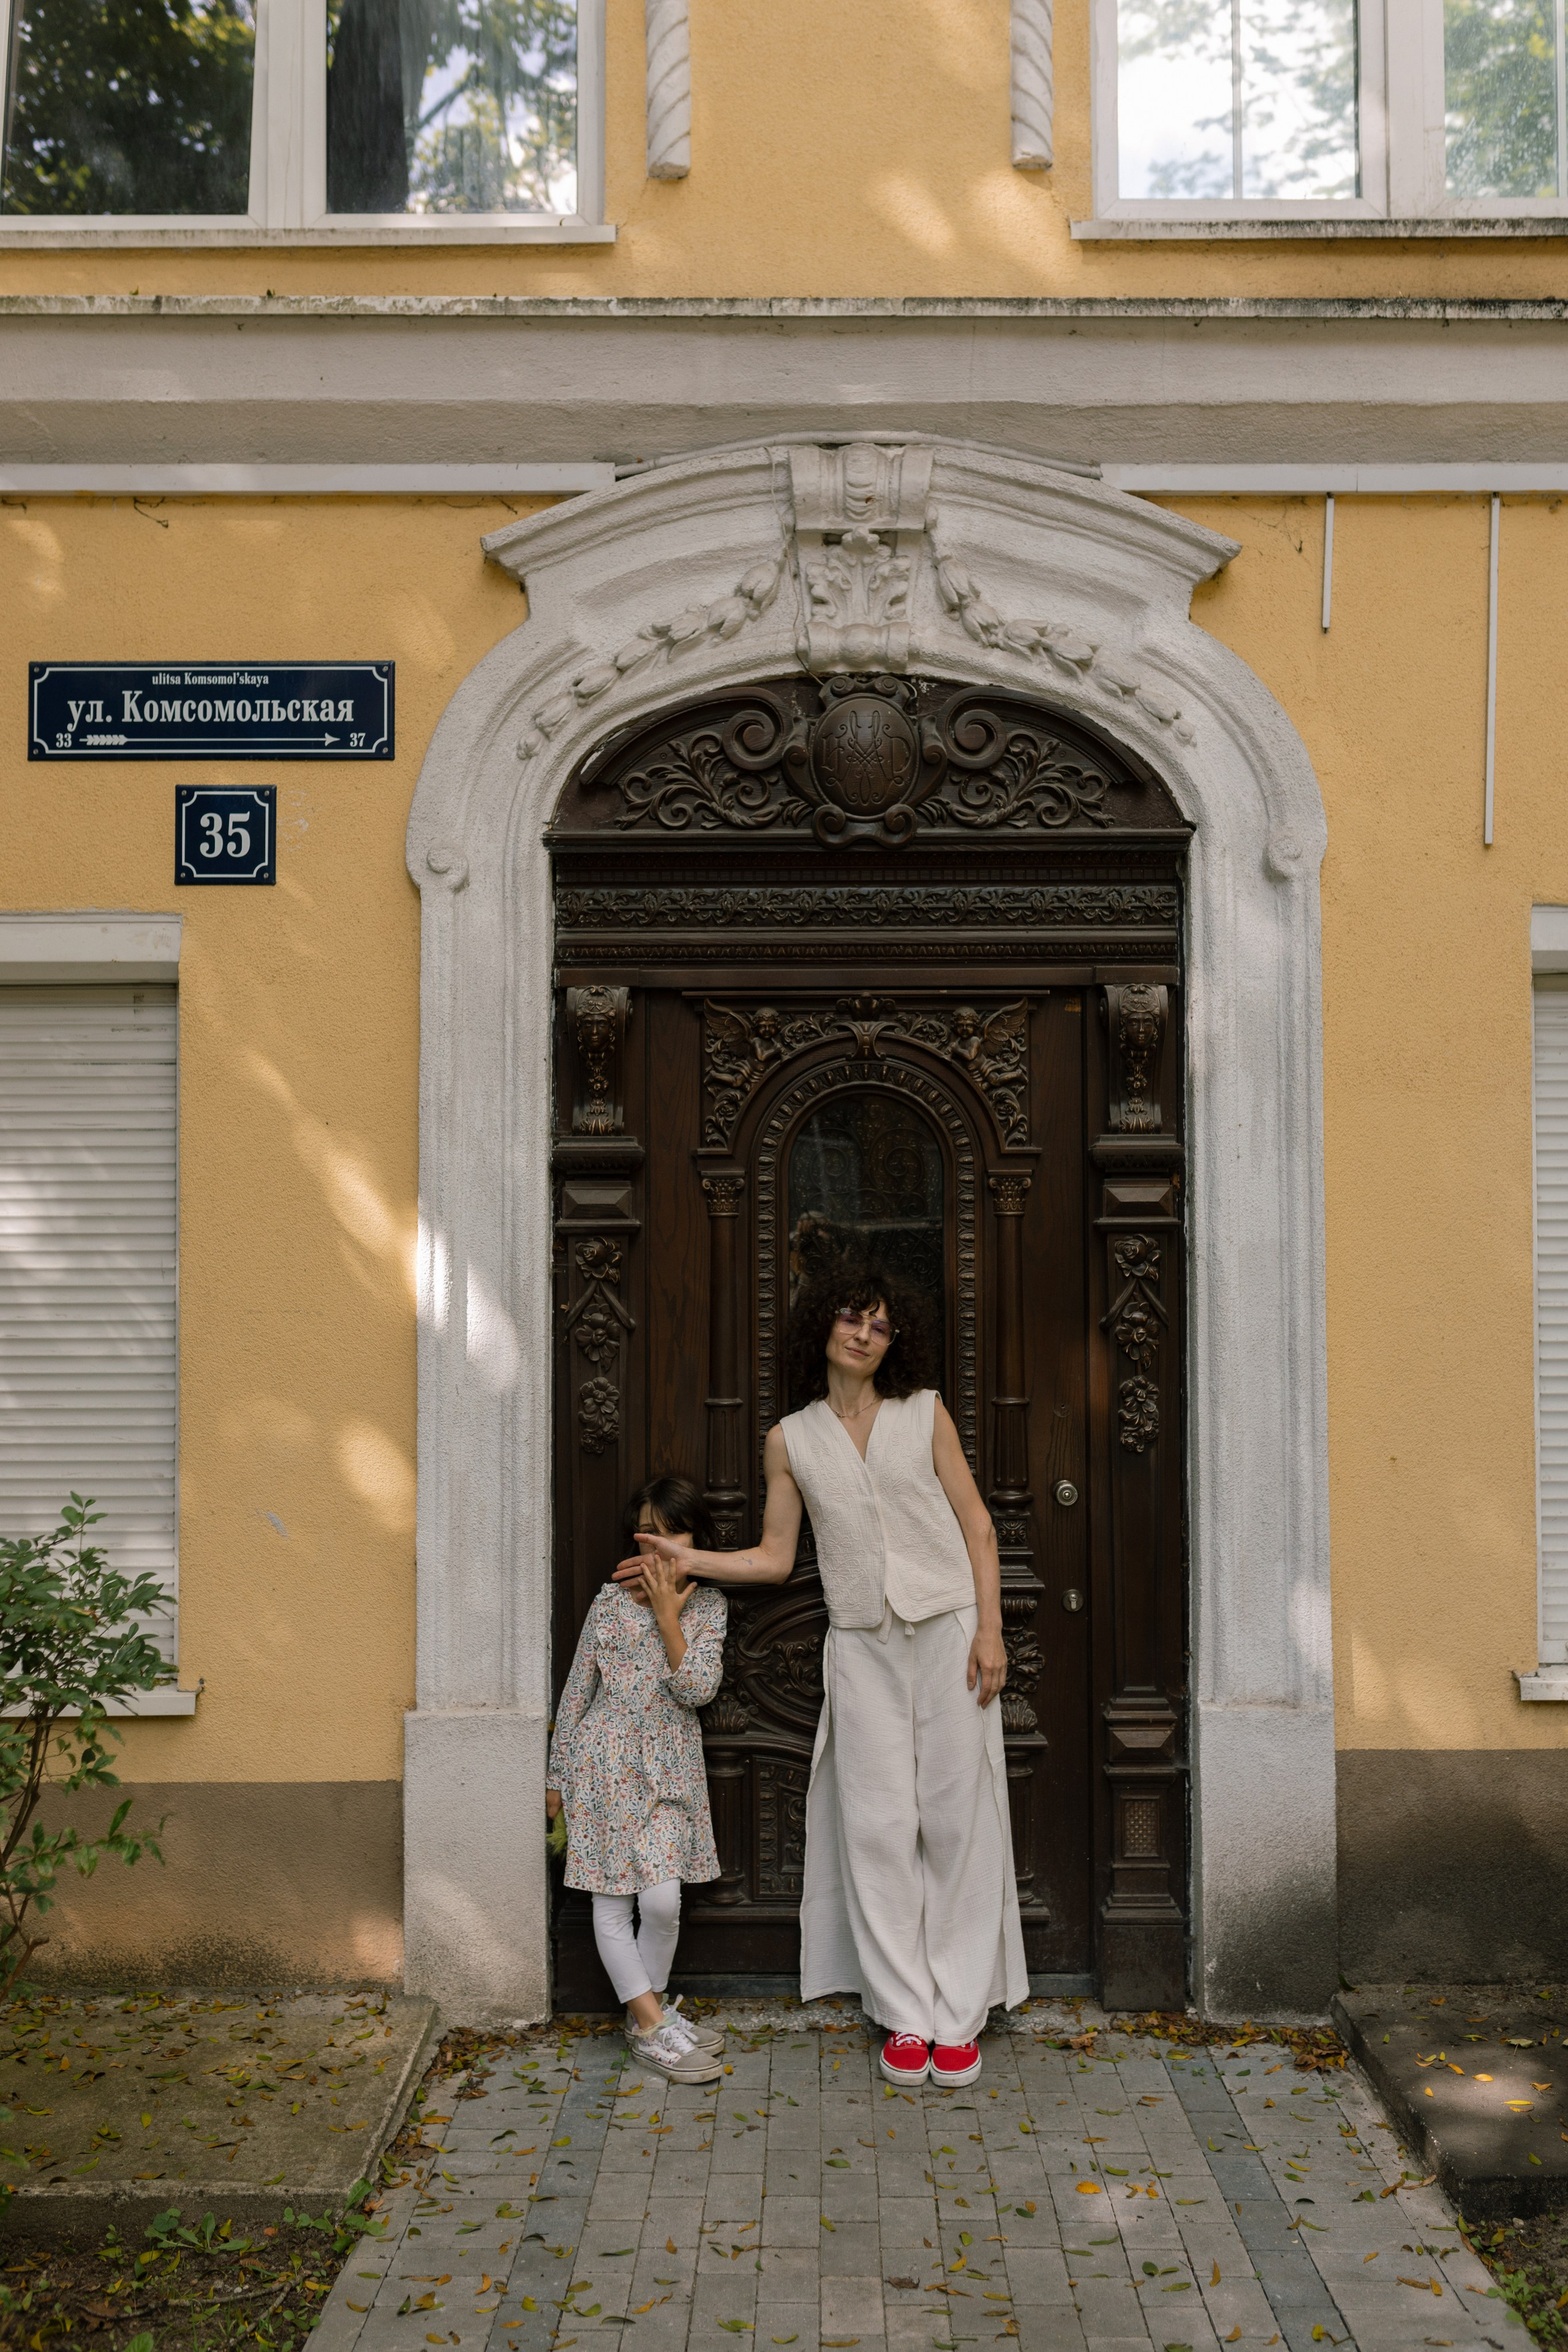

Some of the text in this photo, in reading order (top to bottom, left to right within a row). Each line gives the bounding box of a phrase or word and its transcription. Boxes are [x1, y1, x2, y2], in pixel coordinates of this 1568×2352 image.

[152, 673, 181, 685] ulitsa
[67, 690, 354, 732] ул. Комсомольская
[56, 733, 366, 748] 33 37
[200, 811, 251, 858] 35
